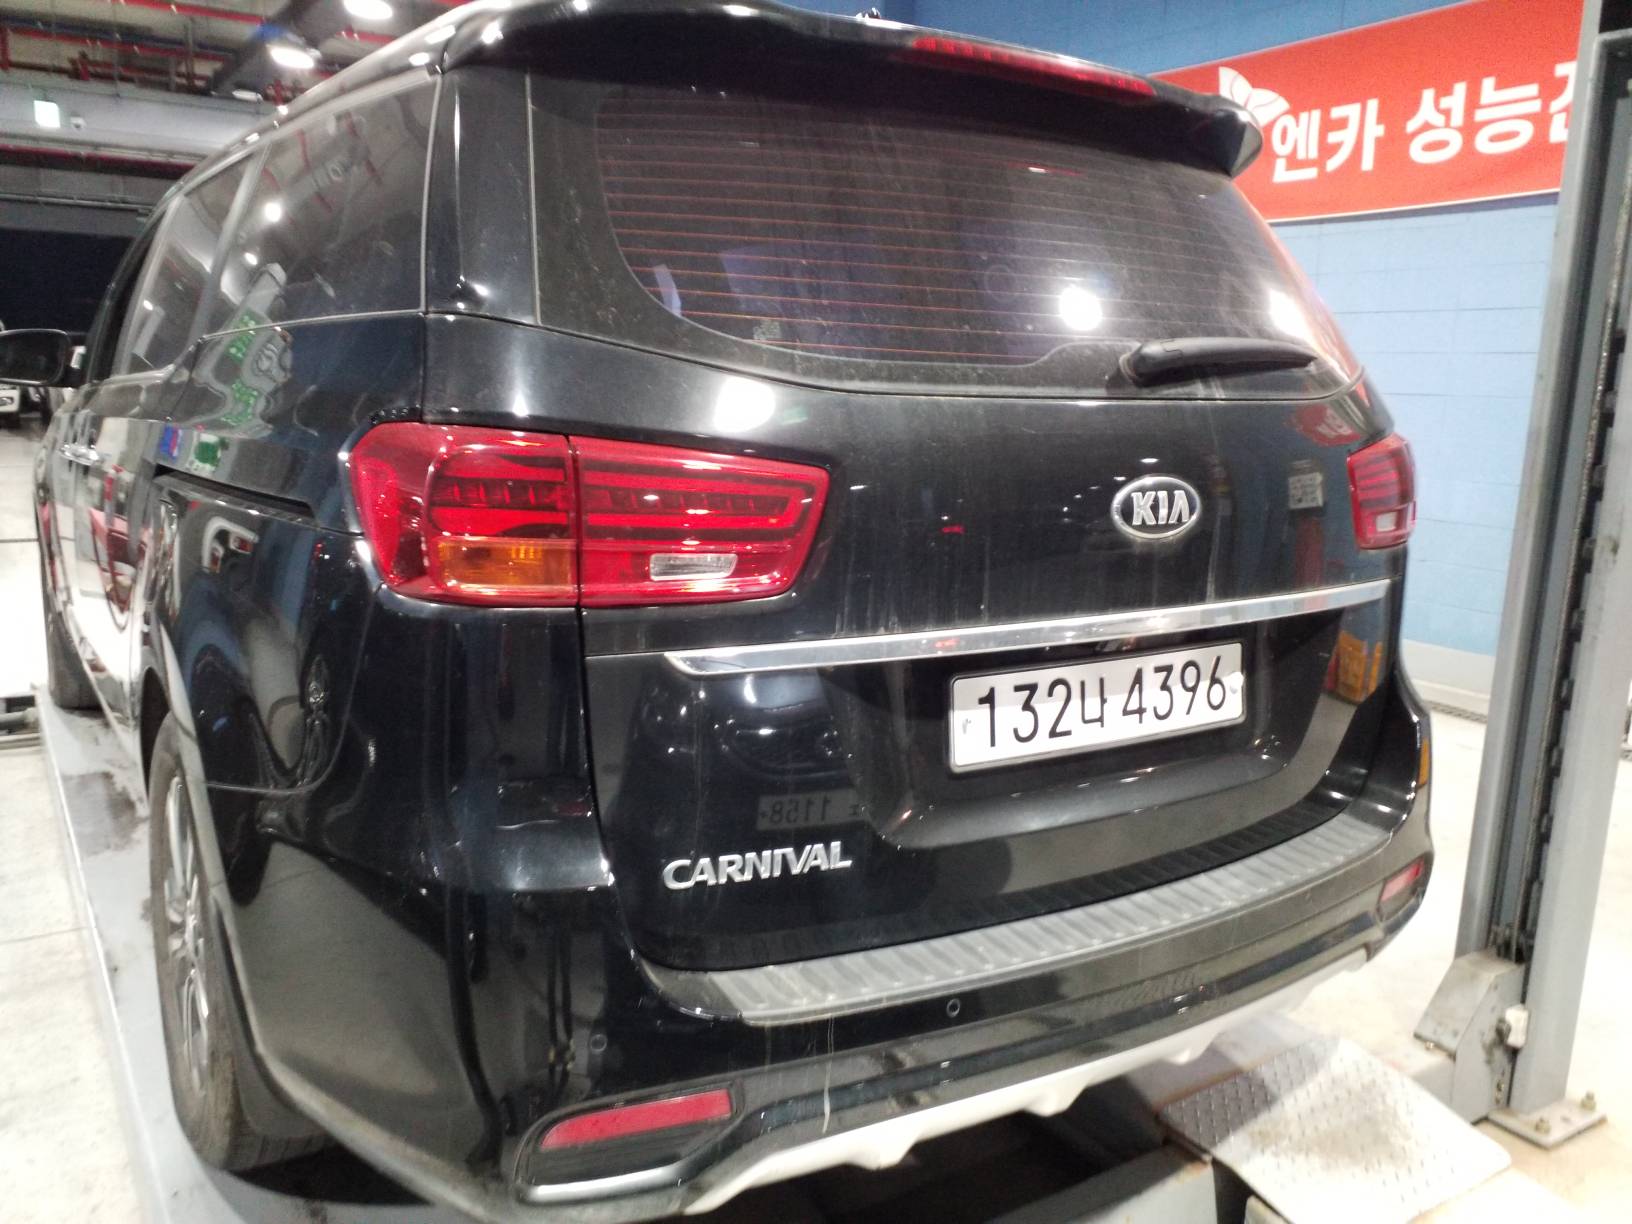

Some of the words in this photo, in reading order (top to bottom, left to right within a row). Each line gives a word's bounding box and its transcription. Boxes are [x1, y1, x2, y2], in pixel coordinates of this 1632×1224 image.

[1272, 98, 1385, 183] 엔카
[1131, 490, 1190, 525] KIA
[977, 676, 1107, 747] 132나
[1122, 655, 1226, 725] 4396
[663, 841, 853, 890] CARNIVAL
